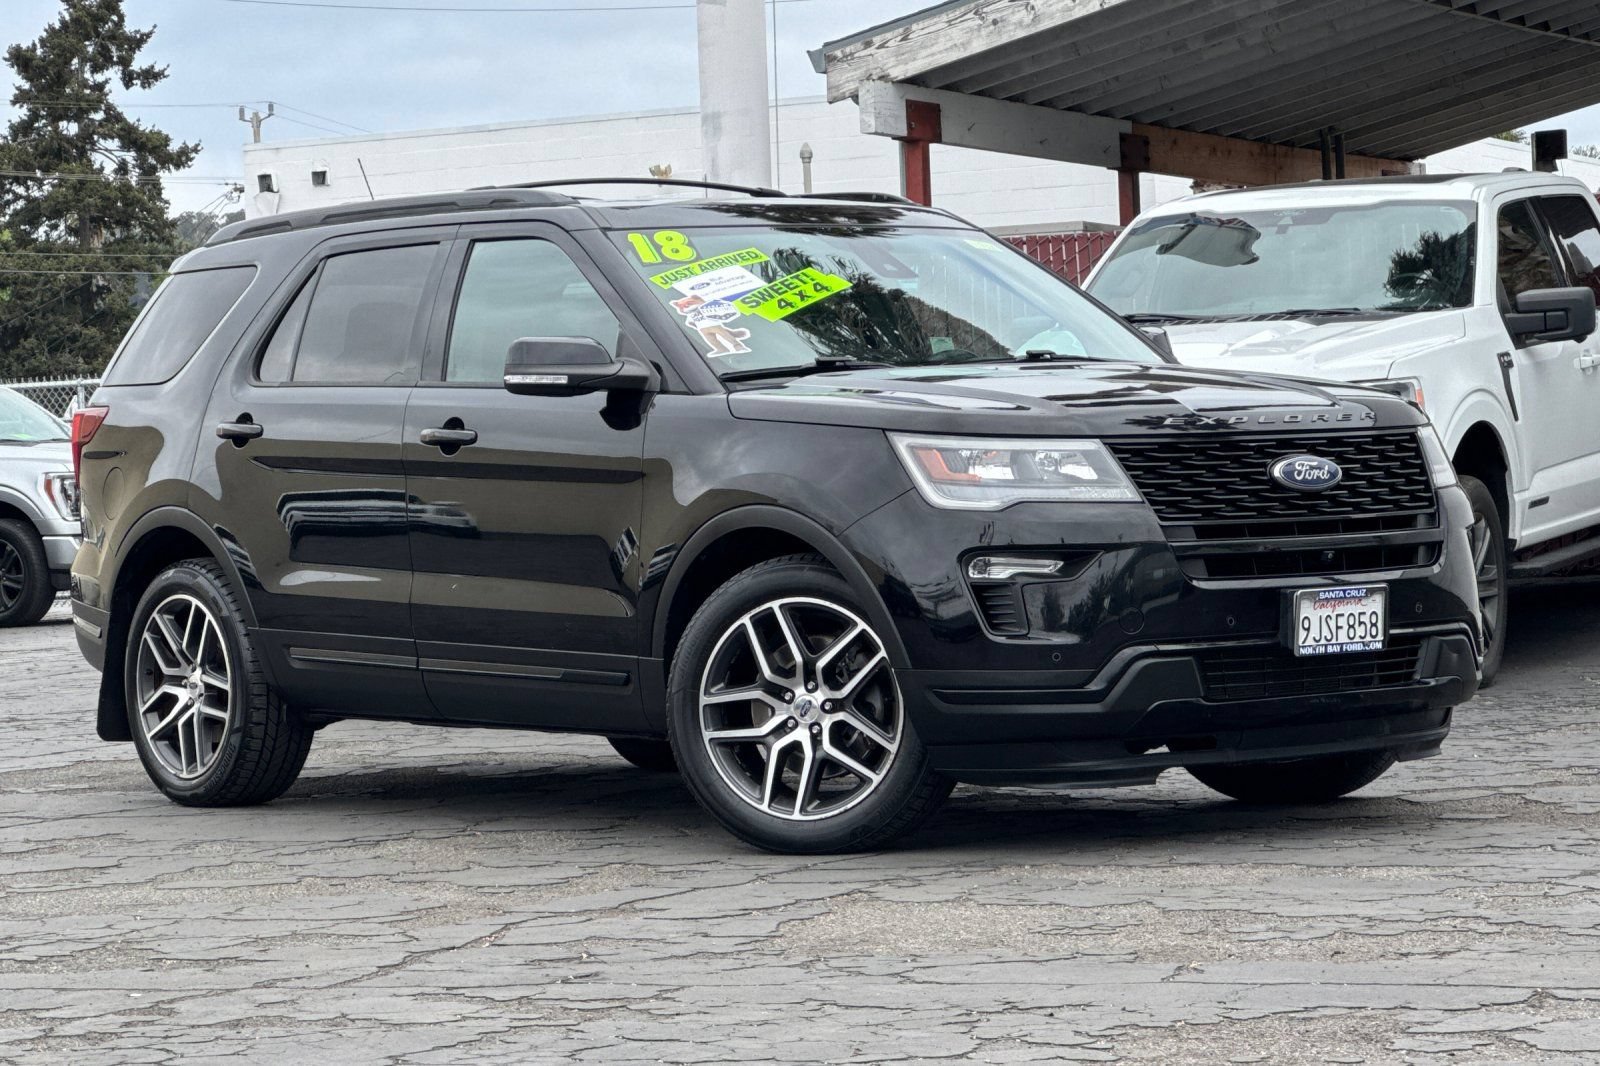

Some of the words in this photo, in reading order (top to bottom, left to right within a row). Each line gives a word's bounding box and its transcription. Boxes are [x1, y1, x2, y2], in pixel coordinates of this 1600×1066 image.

[628, 231, 697, 263] 18
[659, 266, 695, 285] JUST
[698, 250, 761, 273] ARRIVED
[741, 271, 815, 308] SWEET!
[1163, 411, 1377, 425] EXPLORER
[1294, 461, 1330, 480] Ford
[1319, 590, 1343, 599] SANTA
[1345, 589, 1366, 598] CRUZ
[1313, 598, 1367, 613] California
[1301, 611, 1379, 645] 9JSF858
[1327, 644, 1342, 653] BAY
